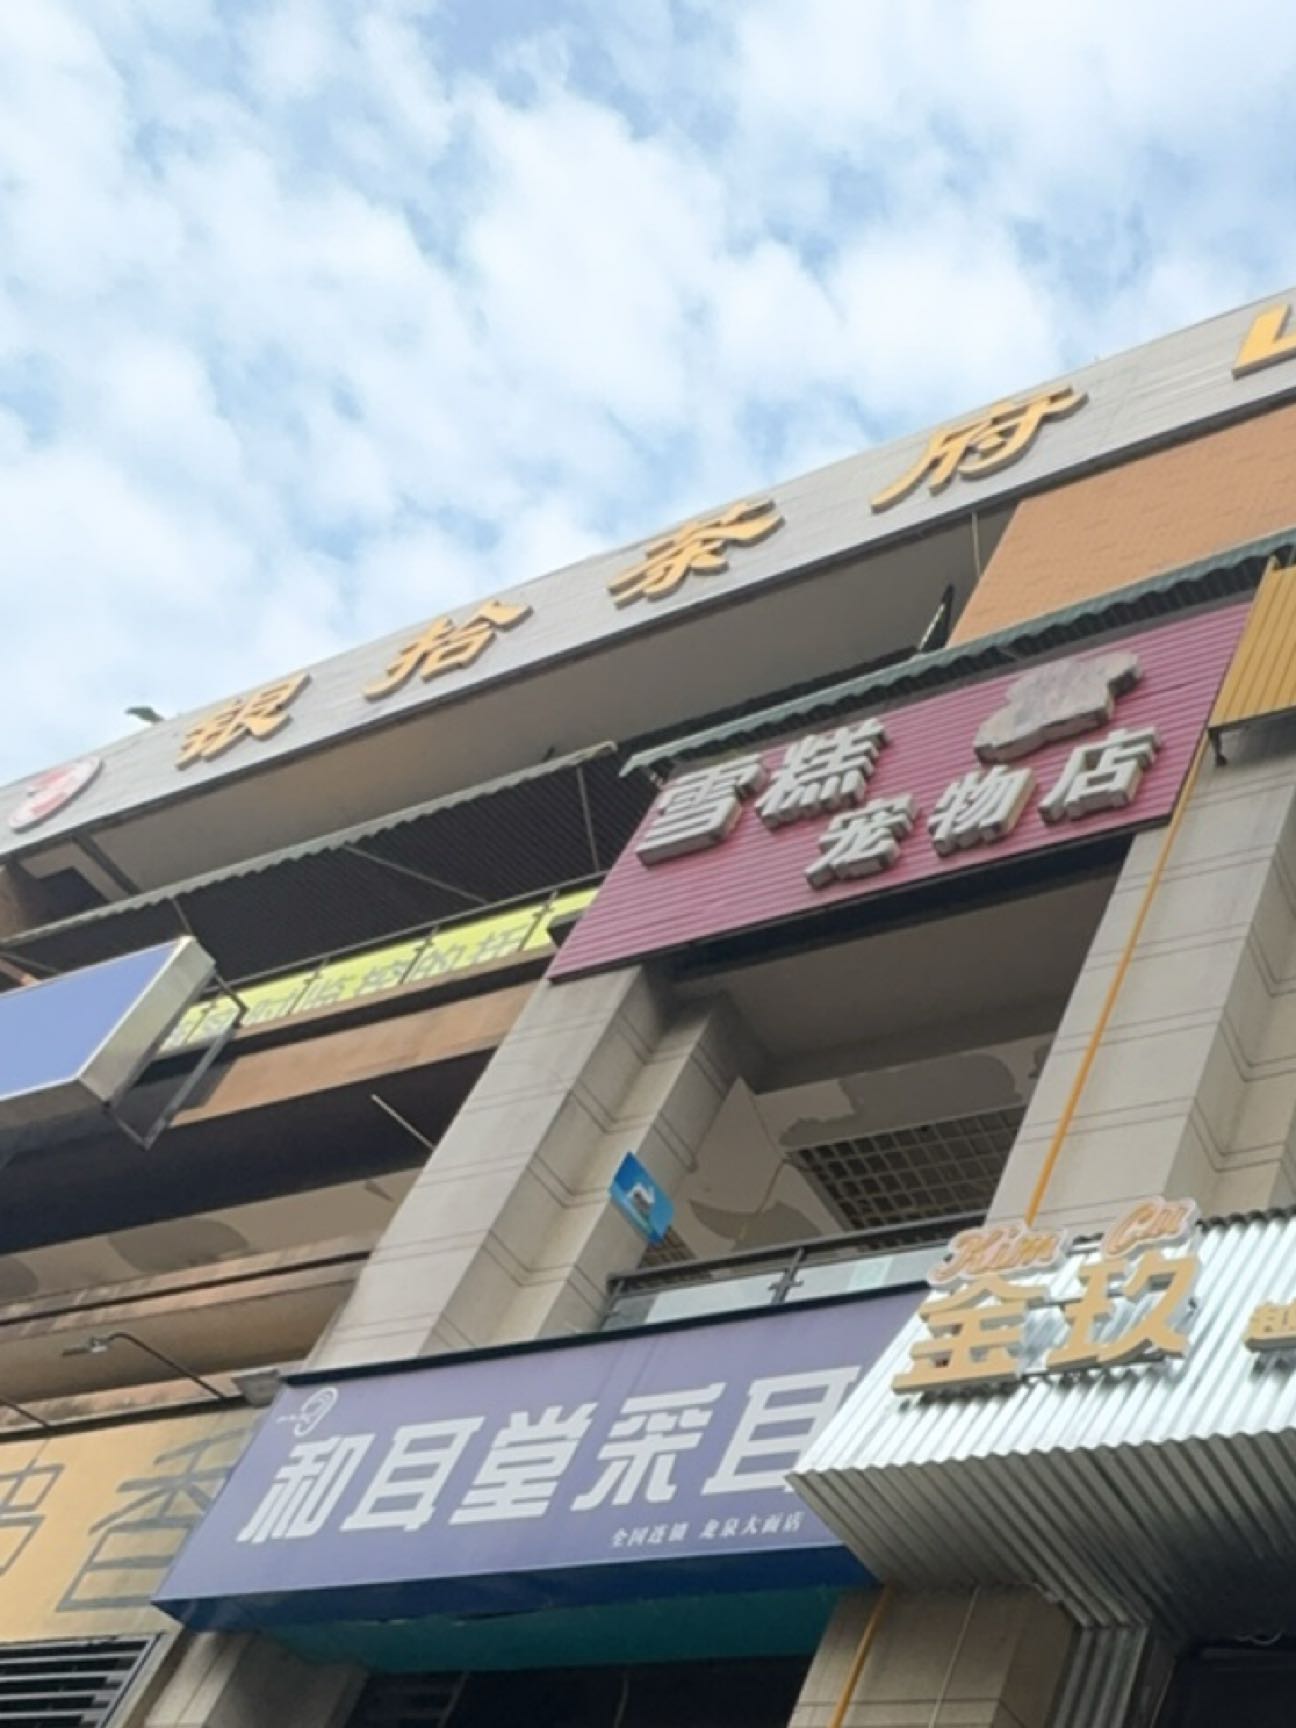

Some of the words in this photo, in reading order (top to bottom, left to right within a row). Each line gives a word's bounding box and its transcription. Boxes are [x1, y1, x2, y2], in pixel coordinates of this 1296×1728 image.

[635, 718, 890, 866] 雪糕
[804, 728, 1162, 890] 宠物店
[893, 1250, 1200, 1393] 金玖
[237, 1366, 860, 1545] 和耳堂采耳
